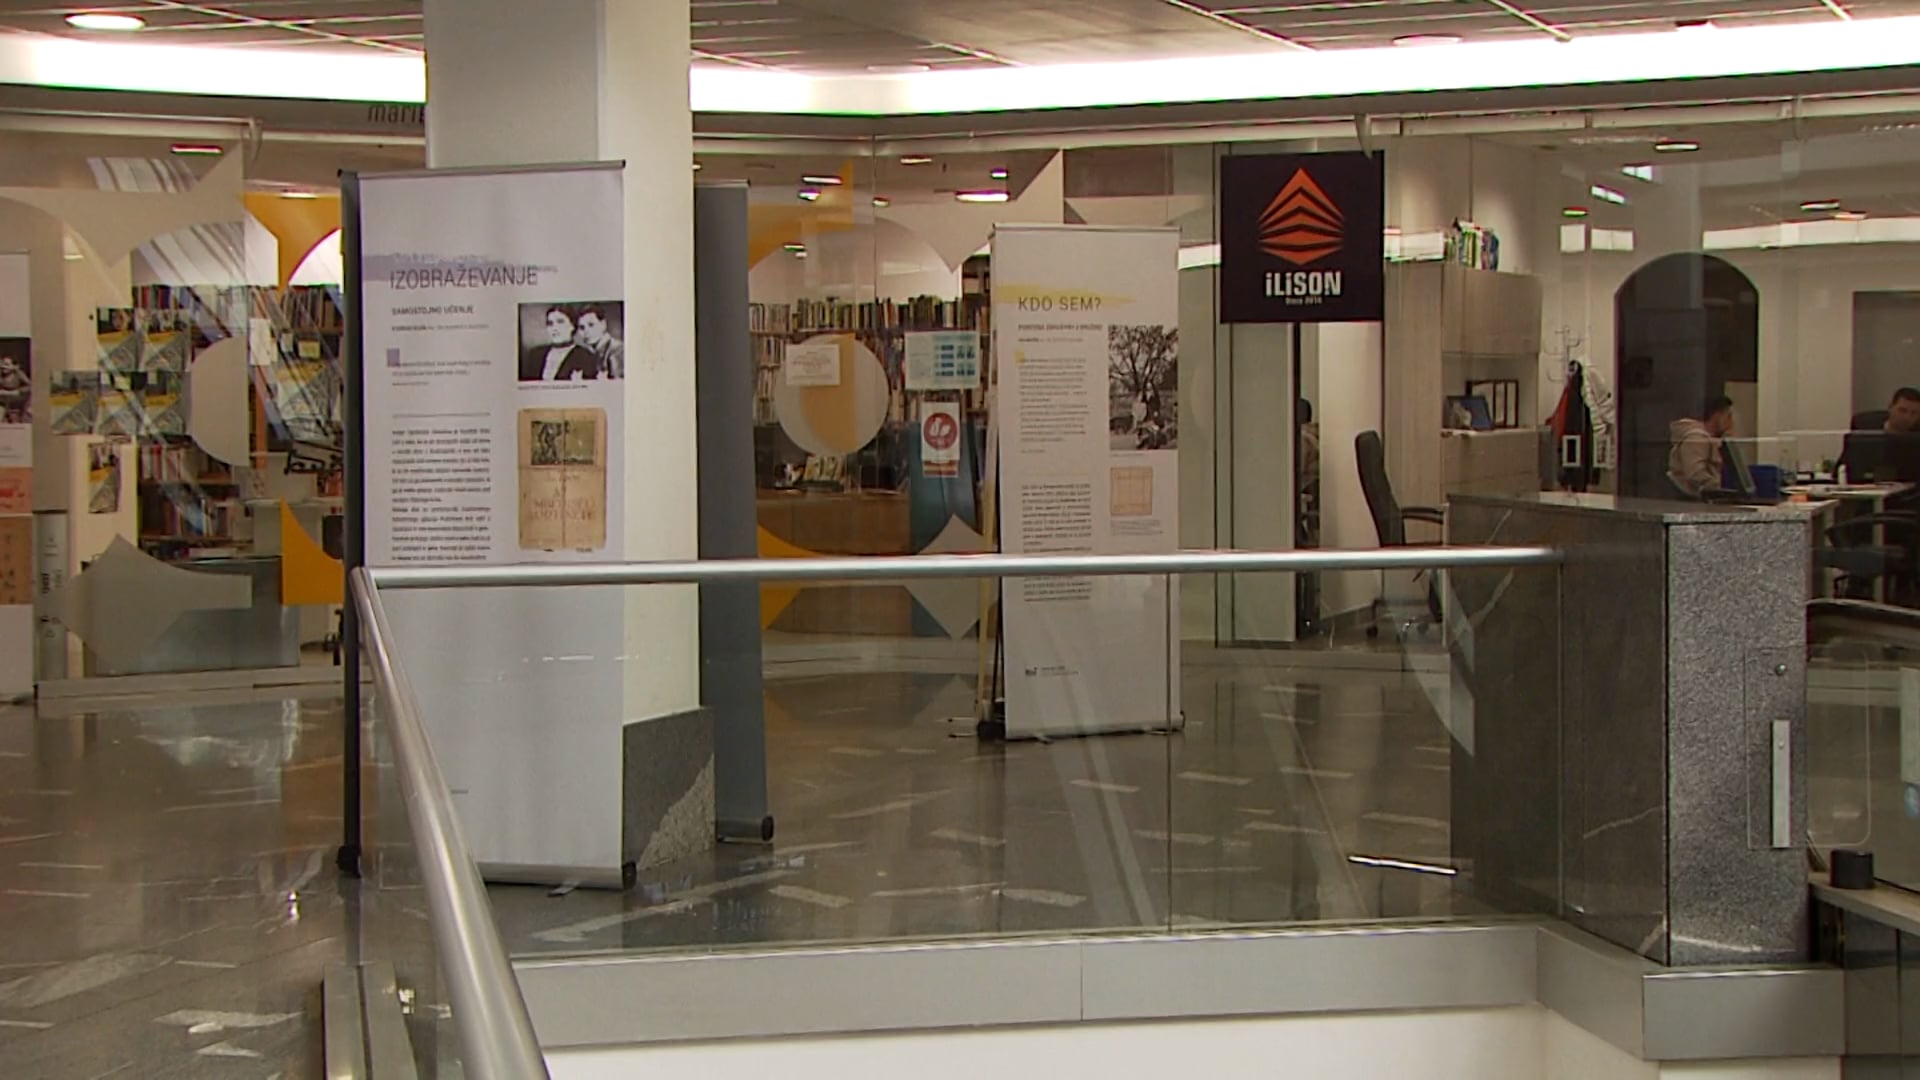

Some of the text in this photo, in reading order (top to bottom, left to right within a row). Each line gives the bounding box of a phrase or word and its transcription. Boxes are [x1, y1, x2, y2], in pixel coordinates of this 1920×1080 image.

[390, 264, 538, 289] IZOBRAŽEVANJE
[1265, 271, 1342, 296] iLiSON
[1018, 295, 1102, 311] KDO SEM?
